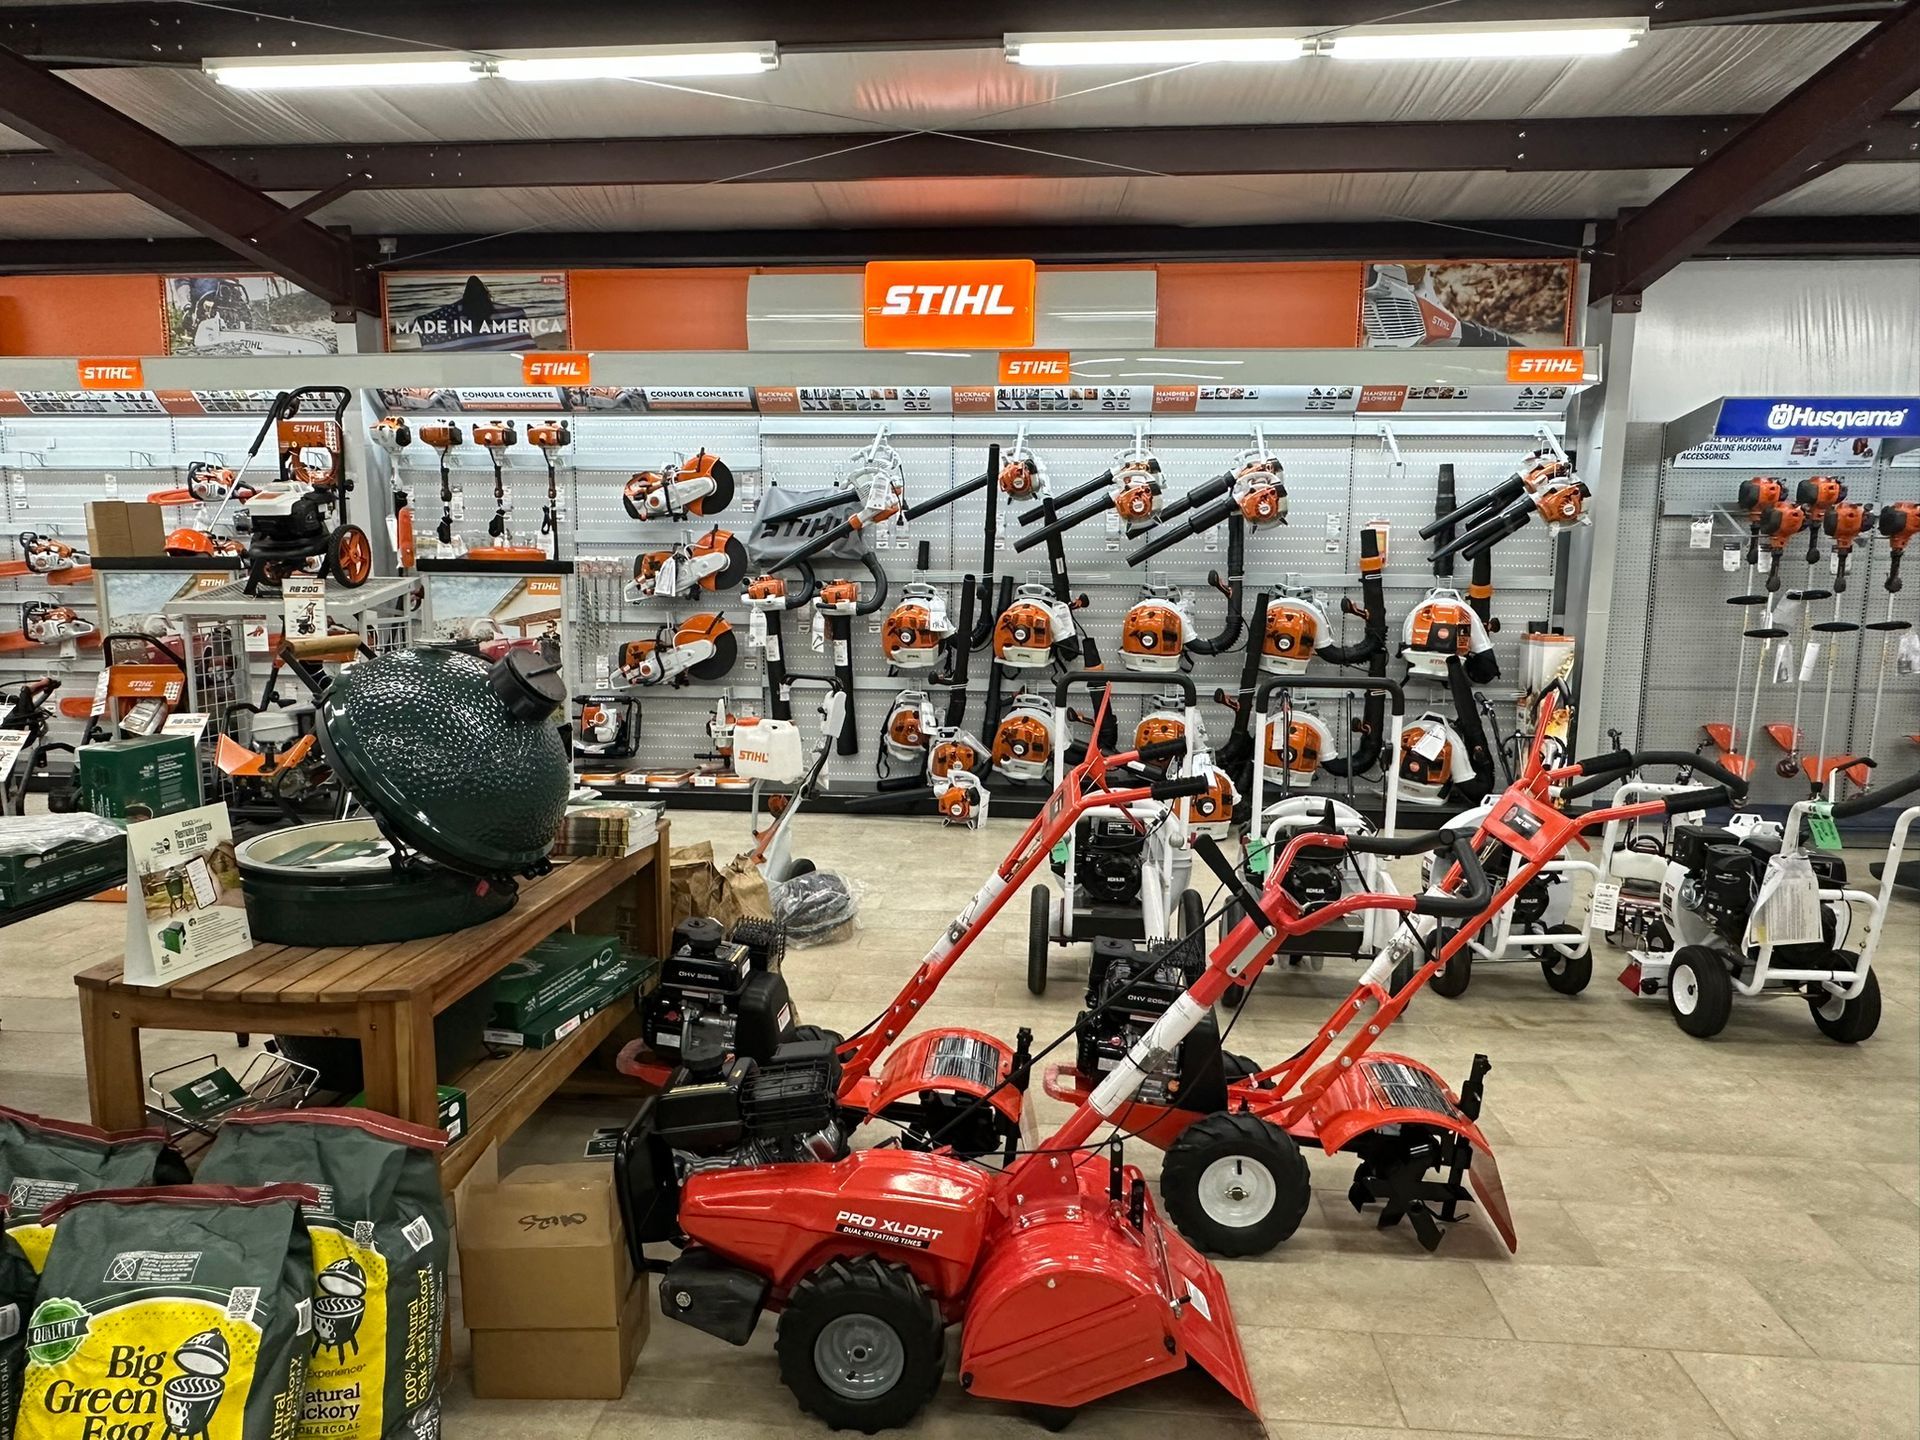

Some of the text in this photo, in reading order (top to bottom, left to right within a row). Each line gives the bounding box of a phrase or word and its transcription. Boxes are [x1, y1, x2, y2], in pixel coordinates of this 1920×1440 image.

[881, 284, 1014, 315] STIHL
[395, 318, 563, 334] MADE IN AMERICA
[1431, 315, 1450, 331] STIHL
[84, 366, 134, 379] STIHL
[529, 362, 581, 375] STIHL
[1008, 361, 1063, 374] STIHL
[1518, 358, 1577, 372] STIHL
[462, 391, 505, 399] CONQUER
[1791, 406, 1906, 429] Husqvarna
[293, 425, 322, 433] STIHL
[1704, 444, 1736, 452] GENUINE
[1736, 444, 1782, 452] HUSQVARNA
[530, 582, 558, 590] STIHL
[128, 680, 154, 688] STIHL
[738, 751, 768, 763] STIHL
[678, 970, 696, 978] OHV
[1127, 994, 1146, 1002] OHV
[836, 1210, 943, 1240] PRO XLDRT
[843, 1226, 922, 1247] DUAL-ROTATING TINES
[33, 1319, 78, 1343] QUALITY
[417, 1269, 429, 1400] Oak and Hickory
[405, 1298, 418, 1407] 100% Natural
[106, 1346, 167, 1386] Big
[44, 1380, 157, 1414] Green
[305, 1382, 360, 1404] atural
[301, 1404, 360, 1421] ickory
[82, 1416, 155, 1440] Egg
